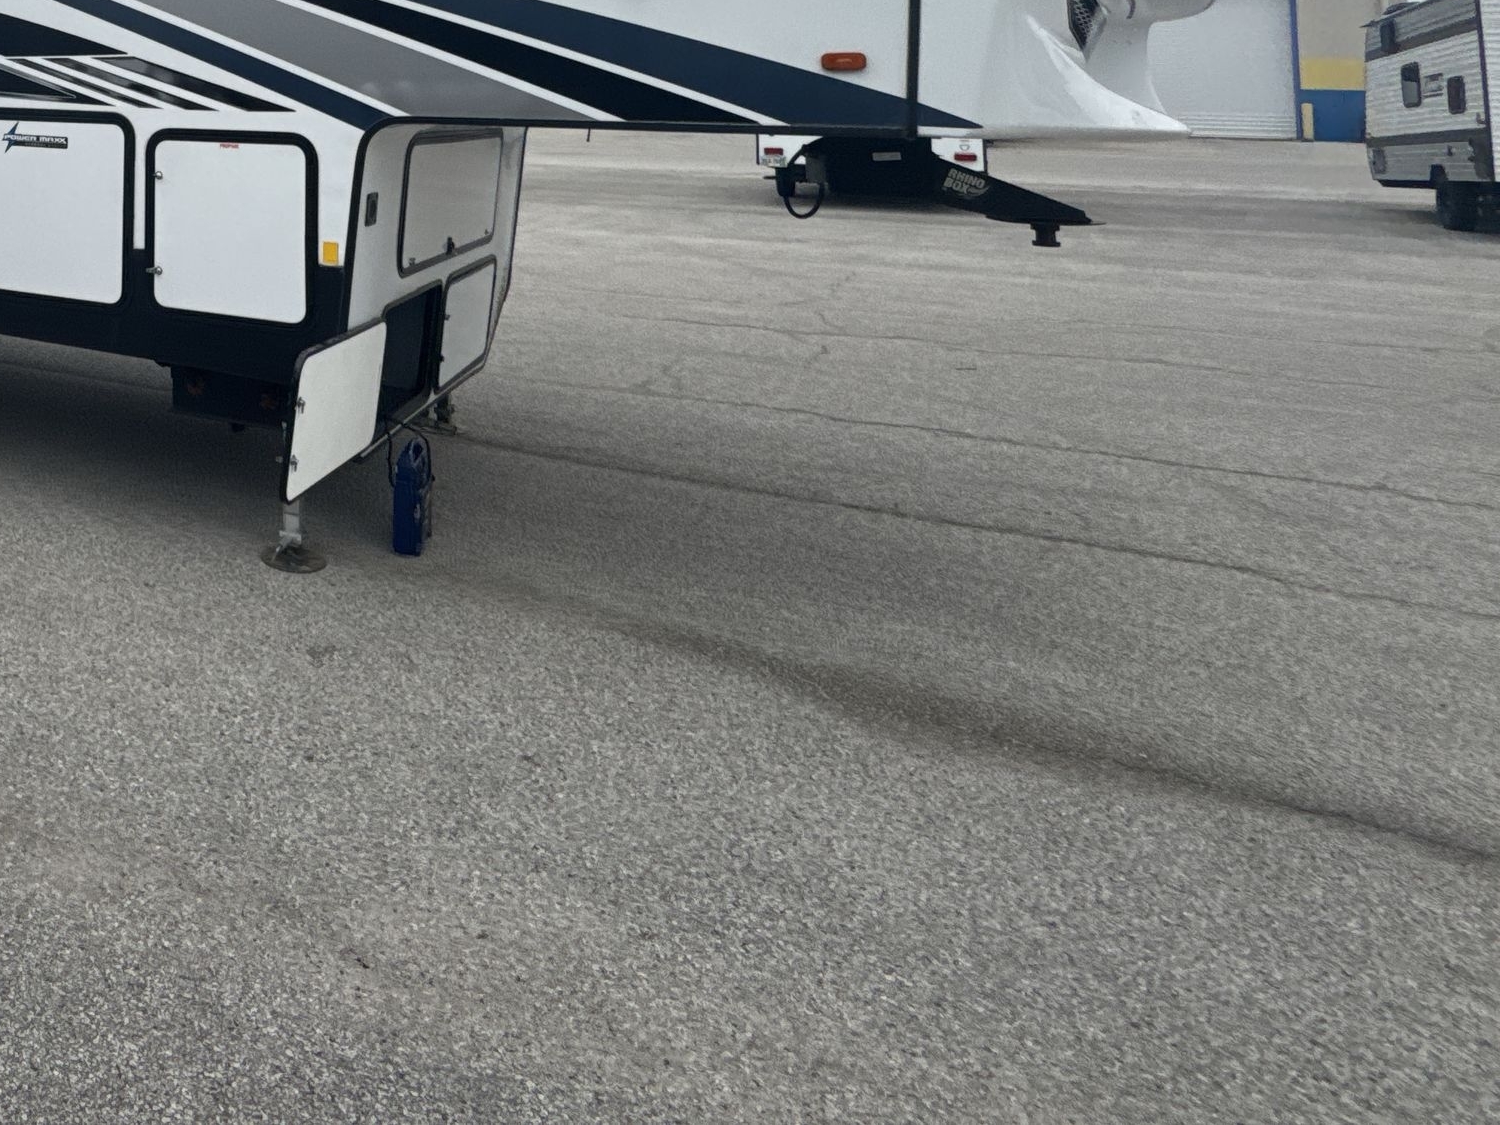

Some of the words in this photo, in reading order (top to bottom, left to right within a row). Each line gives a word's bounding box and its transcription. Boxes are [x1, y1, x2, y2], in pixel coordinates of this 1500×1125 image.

[4, 134, 37, 143] POWER
[943, 177, 970, 194] BOX
[947, 168, 986, 189] RHINO
